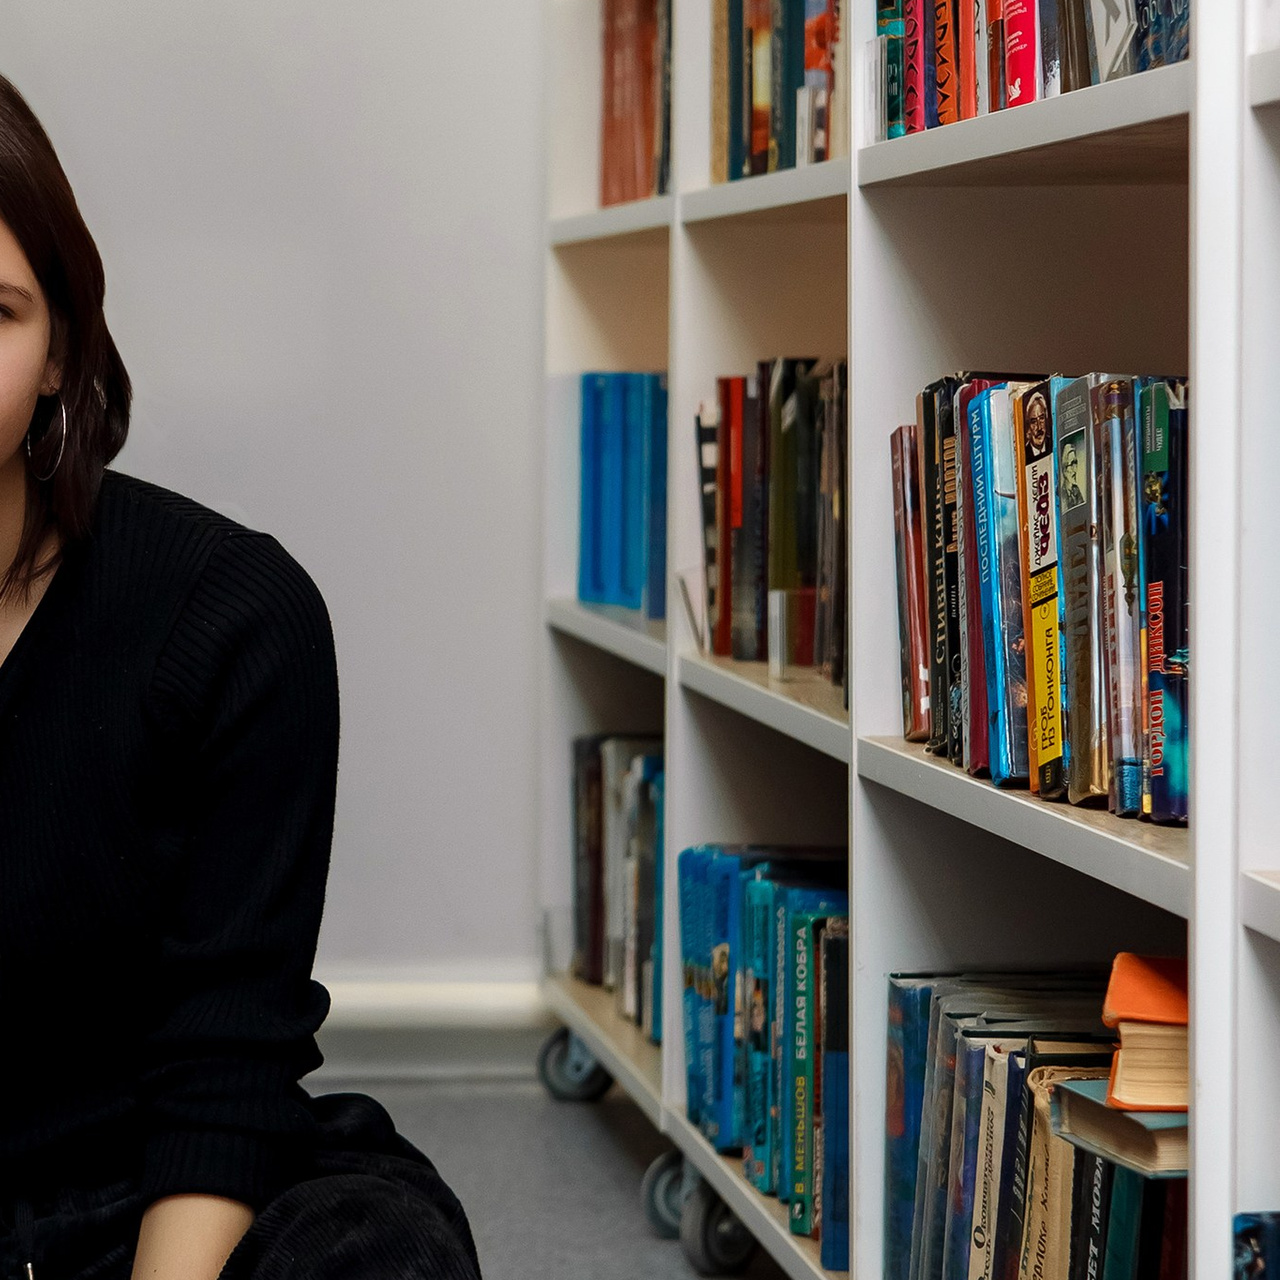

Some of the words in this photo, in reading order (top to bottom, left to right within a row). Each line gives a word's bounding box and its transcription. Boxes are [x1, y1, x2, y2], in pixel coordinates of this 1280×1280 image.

[971, 407, 983, 468] ШТУРМ
[1155, 427, 1163, 452] ЧУДЕС
[975, 472, 990, 584] ПОСЛЕДНИЙ
[1029, 513, 1041, 567] ДЖЕЙМС
[1036, 471, 1051, 558] ЧЕЙЗ
[935, 556, 947, 665] СТИВЕН
[1147, 580, 1165, 675] ДИКСОН
[1045, 627, 1056, 720] ГОНКОНГА
[1040, 706, 1049, 751] ГРОБ
[1046, 726, 1056, 747] ИЗ
[1150, 689, 1165, 777] ГОРДОН
[795, 926, 808, 990] КОБРА
[795, 995, 807, 1060] БЕЛАЯ
[794, 1075, 806, 1172] МЕНЬШОВ
